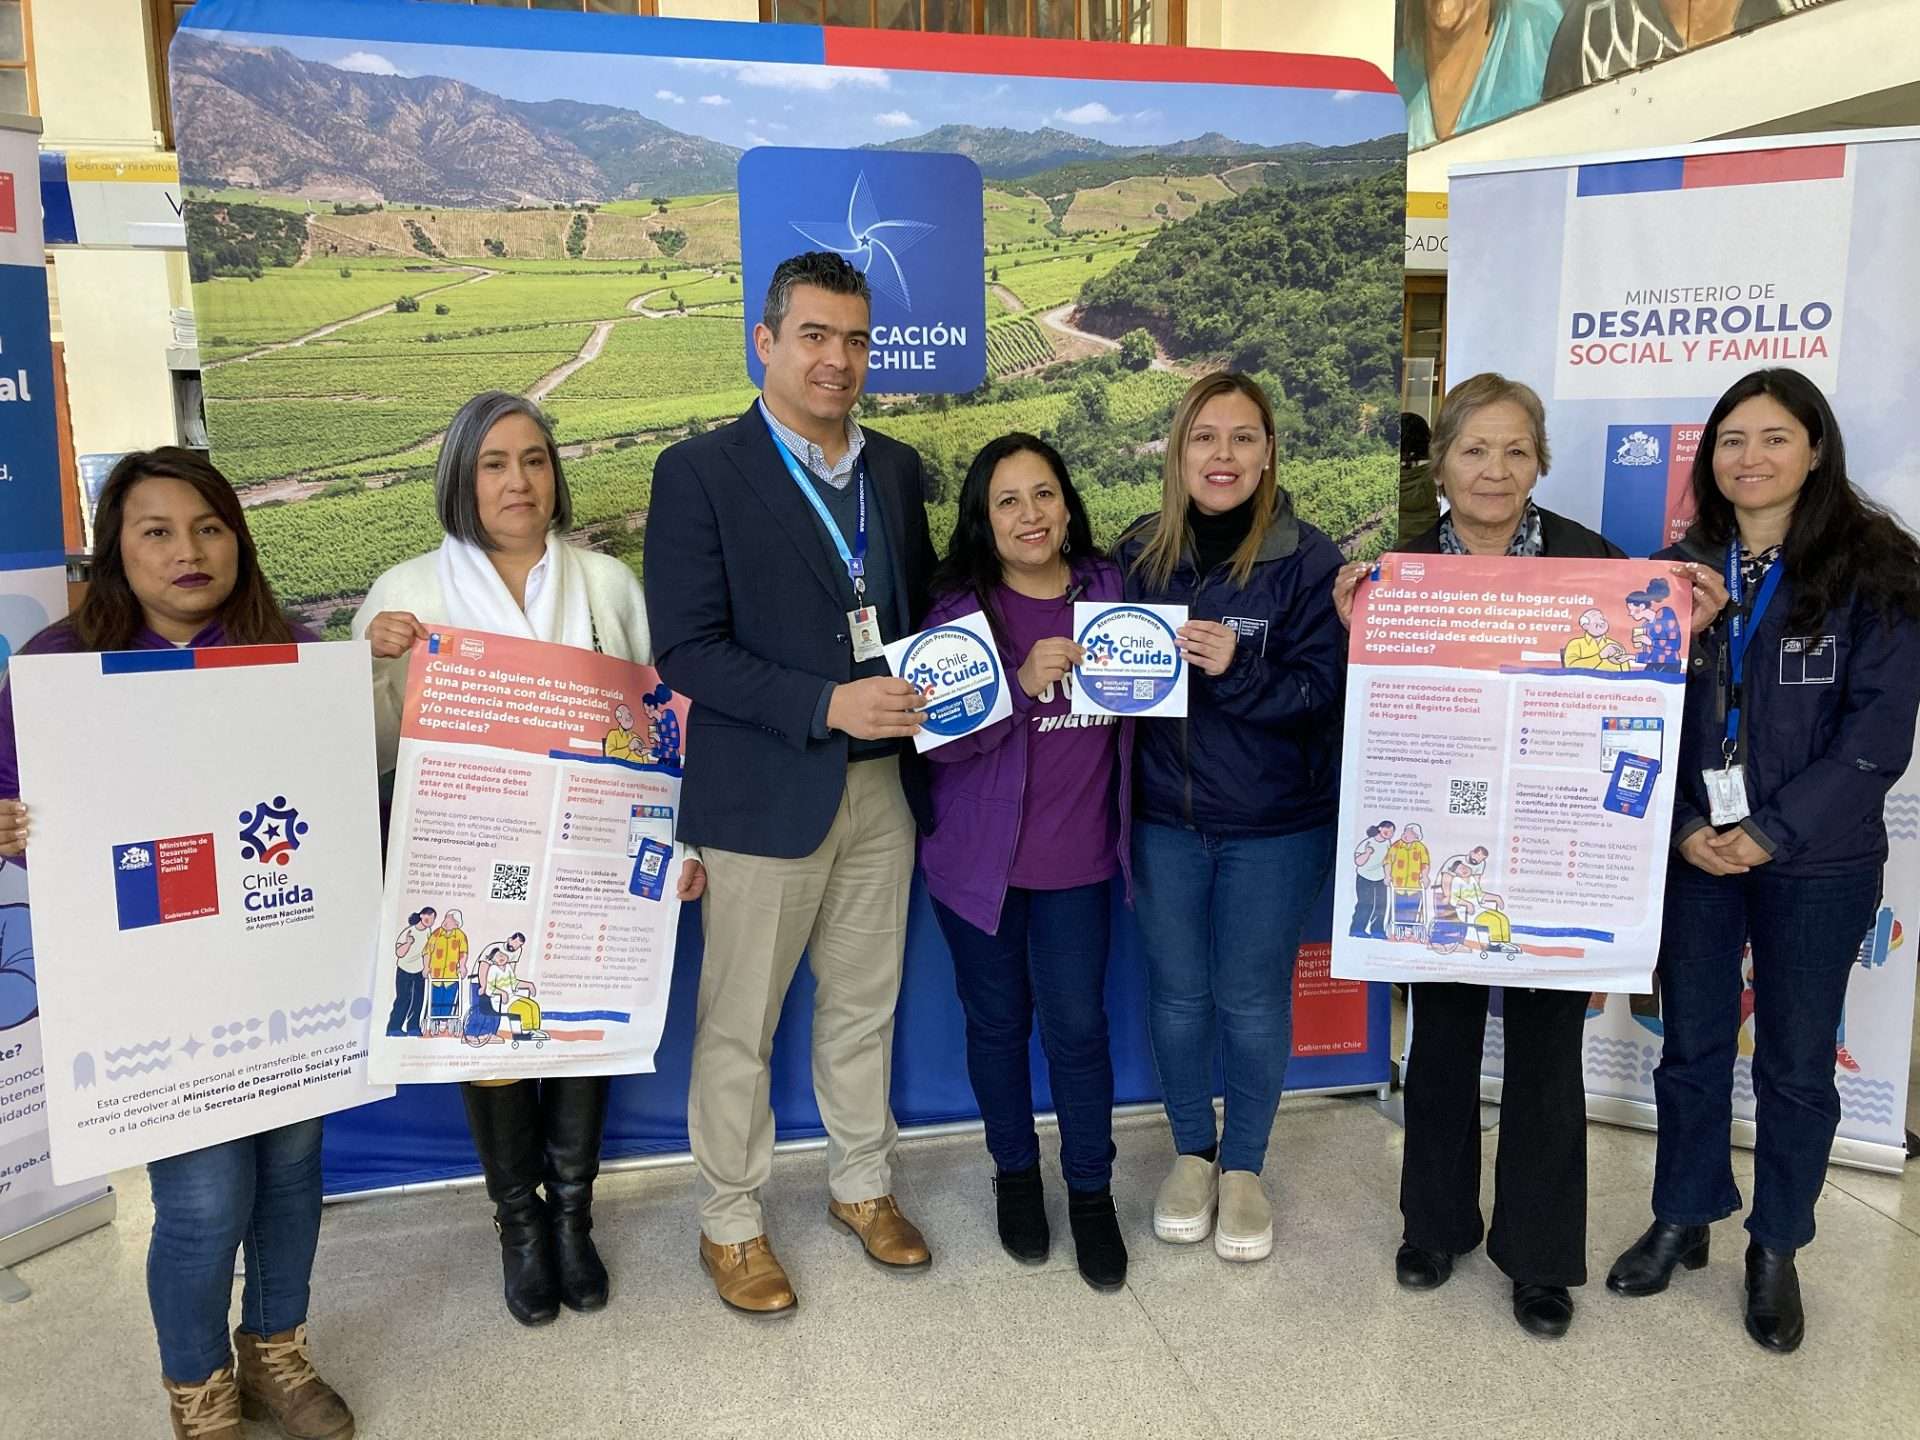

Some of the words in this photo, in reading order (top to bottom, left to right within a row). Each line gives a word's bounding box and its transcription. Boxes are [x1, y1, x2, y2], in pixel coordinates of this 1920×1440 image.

[1626, 286, 1741, 305] MINISTERIO
[1749, 284, 1775, 299] DE
[1572, 302, 1832, 339] DESARROLLO
[872, 324, 966, 346] CACIÓN
[1570, 342, 1672, 365] SOCIAL
[1683, 341, 1700, 362] Y
[1709, 336, 1828, 361] FAMILIA
[870, 351, 936, 369] CHILE
[1678, 431, 1704, 441] SER
[1369, 588, 1417, 600] ¿Cuidas
[1431, 590, 1478, 602] alguien
[1482, 592, 1497, 601] de
[1501, 594, 1514, 602] tu
[1517, 593, 1555, 606] hogar
[1558, 595, 1594, 605] cuida
[1378, 604, 1401, 612] una
[1404, 605, 1455, 614] persona
[1458, 607, 1482, 615] con
[1485, 606, 1572, 619] discapacidad,
[1097, 613, 1126, 630] Atención
[1127, 612, 1161, 631] Preferente
[1367, 615, 1447, 627] dependencia
[1451, 619, 1514, 630] moderada
[1530, 624, 1571, 632] severa
[1120, 636, 1154, 649] Chile
[1366, 628, 1387, 640] y/o
[1390, 630, 1466, 641] necesidades
[1469, 633, 1537, 645] educativas
[910, 638, 934, 661] Atención
[933, 633, 968, 643] Preferente
[1366, 643, 1436, 654] especiales?
[937, 653, 968, 671] Chile
[1120, 650, 1172, 665] Cuida
[426, 662, 475, 676] ¿Cuidas
[489, 671, 534, 685] alguien
[537, 678, 552, 687] de
[555, 680, 566, 689] tu
[569, 682, 599, 695] hogar
[601, 690, 623, 700] cuida
[942, 661, 989, 686] Cuida
[436, 678, 458, 688] una
[462, 681, 511, 695] persona
[514, 689, 536, 698] con
[539, 691, 610, 711] discapacidad,
[1407, 694, 1451, 702] cuidadora
[1538, 691, 1584, 699] credencial
[1594, 694, 1644, 702] certificado
[424, 688, 503, 708] dependencia
[506, 702, 565, 716] moderada
[578, 712, 610, 723] severa
[1416, 704, 1452, 712] Registro
[1454, 706, 1480, 714] Social
[1522, 710, 1568, 718] permitirá:
[1562, 702, 1607, 710] cuidadora
[421, 704, 442, 713] y/o
[445, 707, 520, 723] necesidades
[523, 717, 584, 732] educativas
[1382, 712, 1417, 720] Hogares
[419, 718, 490, 733] especiales?
[160, 840, 197, 850] Ministerio
[160, 848, 198, 858] Desarrollo
[161, 857, 183, 865] Social
[161, 864, 188, 873] Familia
[243, 872, 288, 890] Chile
[245, 885, 313, 911] Cuida
[245, 913, 278, 924] Sistema
[279, 906, 314, 918] Nacional
[256, 921, 279, 930] Apoyos
[286, 915, 315, 924] Cuidados
[1298, 948, 1330, 958] Servici
[1298, 959, 1329, 970] Registr
[1298, 969, 1330, 979] Identif
[98, 1099, 119, 1109] Esta
[122, 1084, 176, 1103] credencial
[193, 1069, 235, 1088] personal
[324, 1044, 344, 1054] caso
[124, 1102, 168, 1117] devolver
[172, 1097, 180, 1105] al
[184, 1085, 236, 1102] Ministerio
[238, 1081, 250, 1089] de
[253, 1068, 303, 1085] Desarrollo
[305, 1059, 333, 1072] Social
[335, 1058, 340, 1066] y
[342, 1050, 368, 1062] Famili
[141, 1114, 175, 1127] oficina
[178, 1110, 190, 1118] de
[205, 1093, 256, 1111] Secretaría
[259, 1080, 301, 1098] Regional
[304, 1067, 352, 1086] Ministerial
